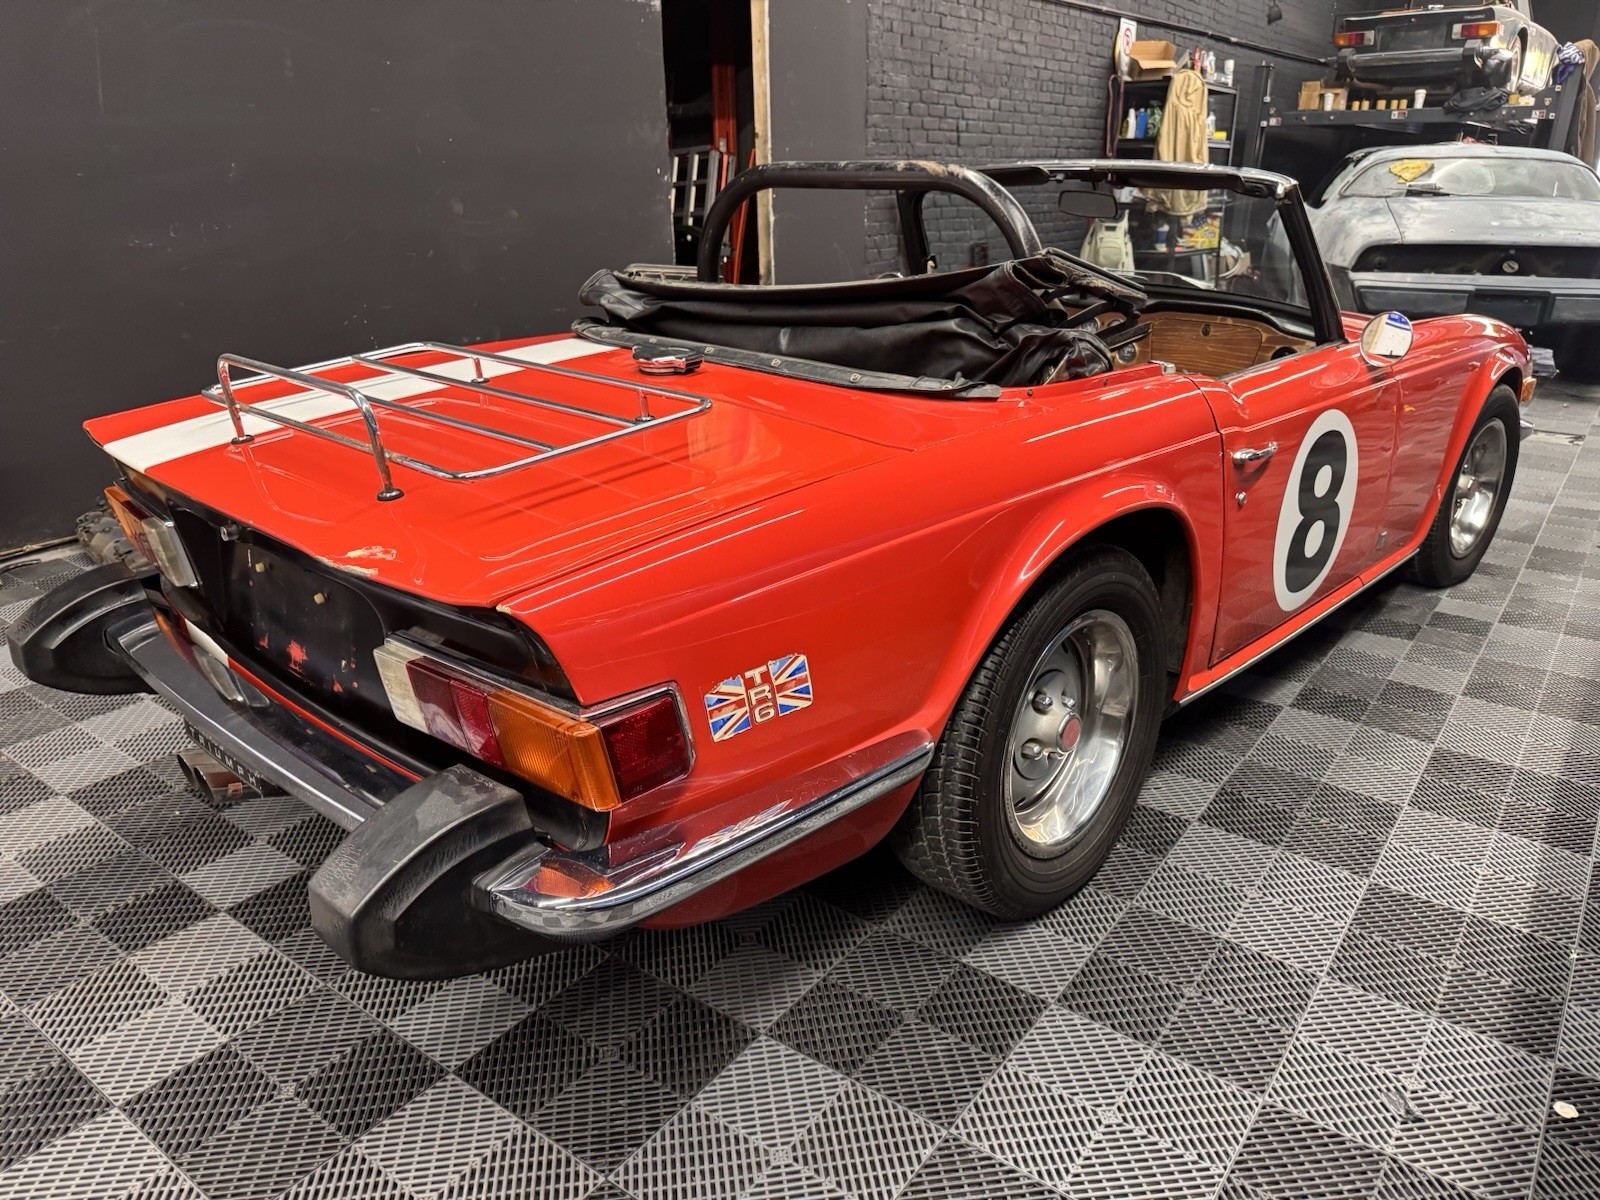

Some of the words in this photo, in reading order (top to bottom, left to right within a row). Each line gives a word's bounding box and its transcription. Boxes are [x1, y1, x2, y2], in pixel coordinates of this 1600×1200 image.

[1285, 429, 1347, 593] 8
[744, 665, 775, 724] TR6
[189, 724, 257, 787] TRIUMPH
